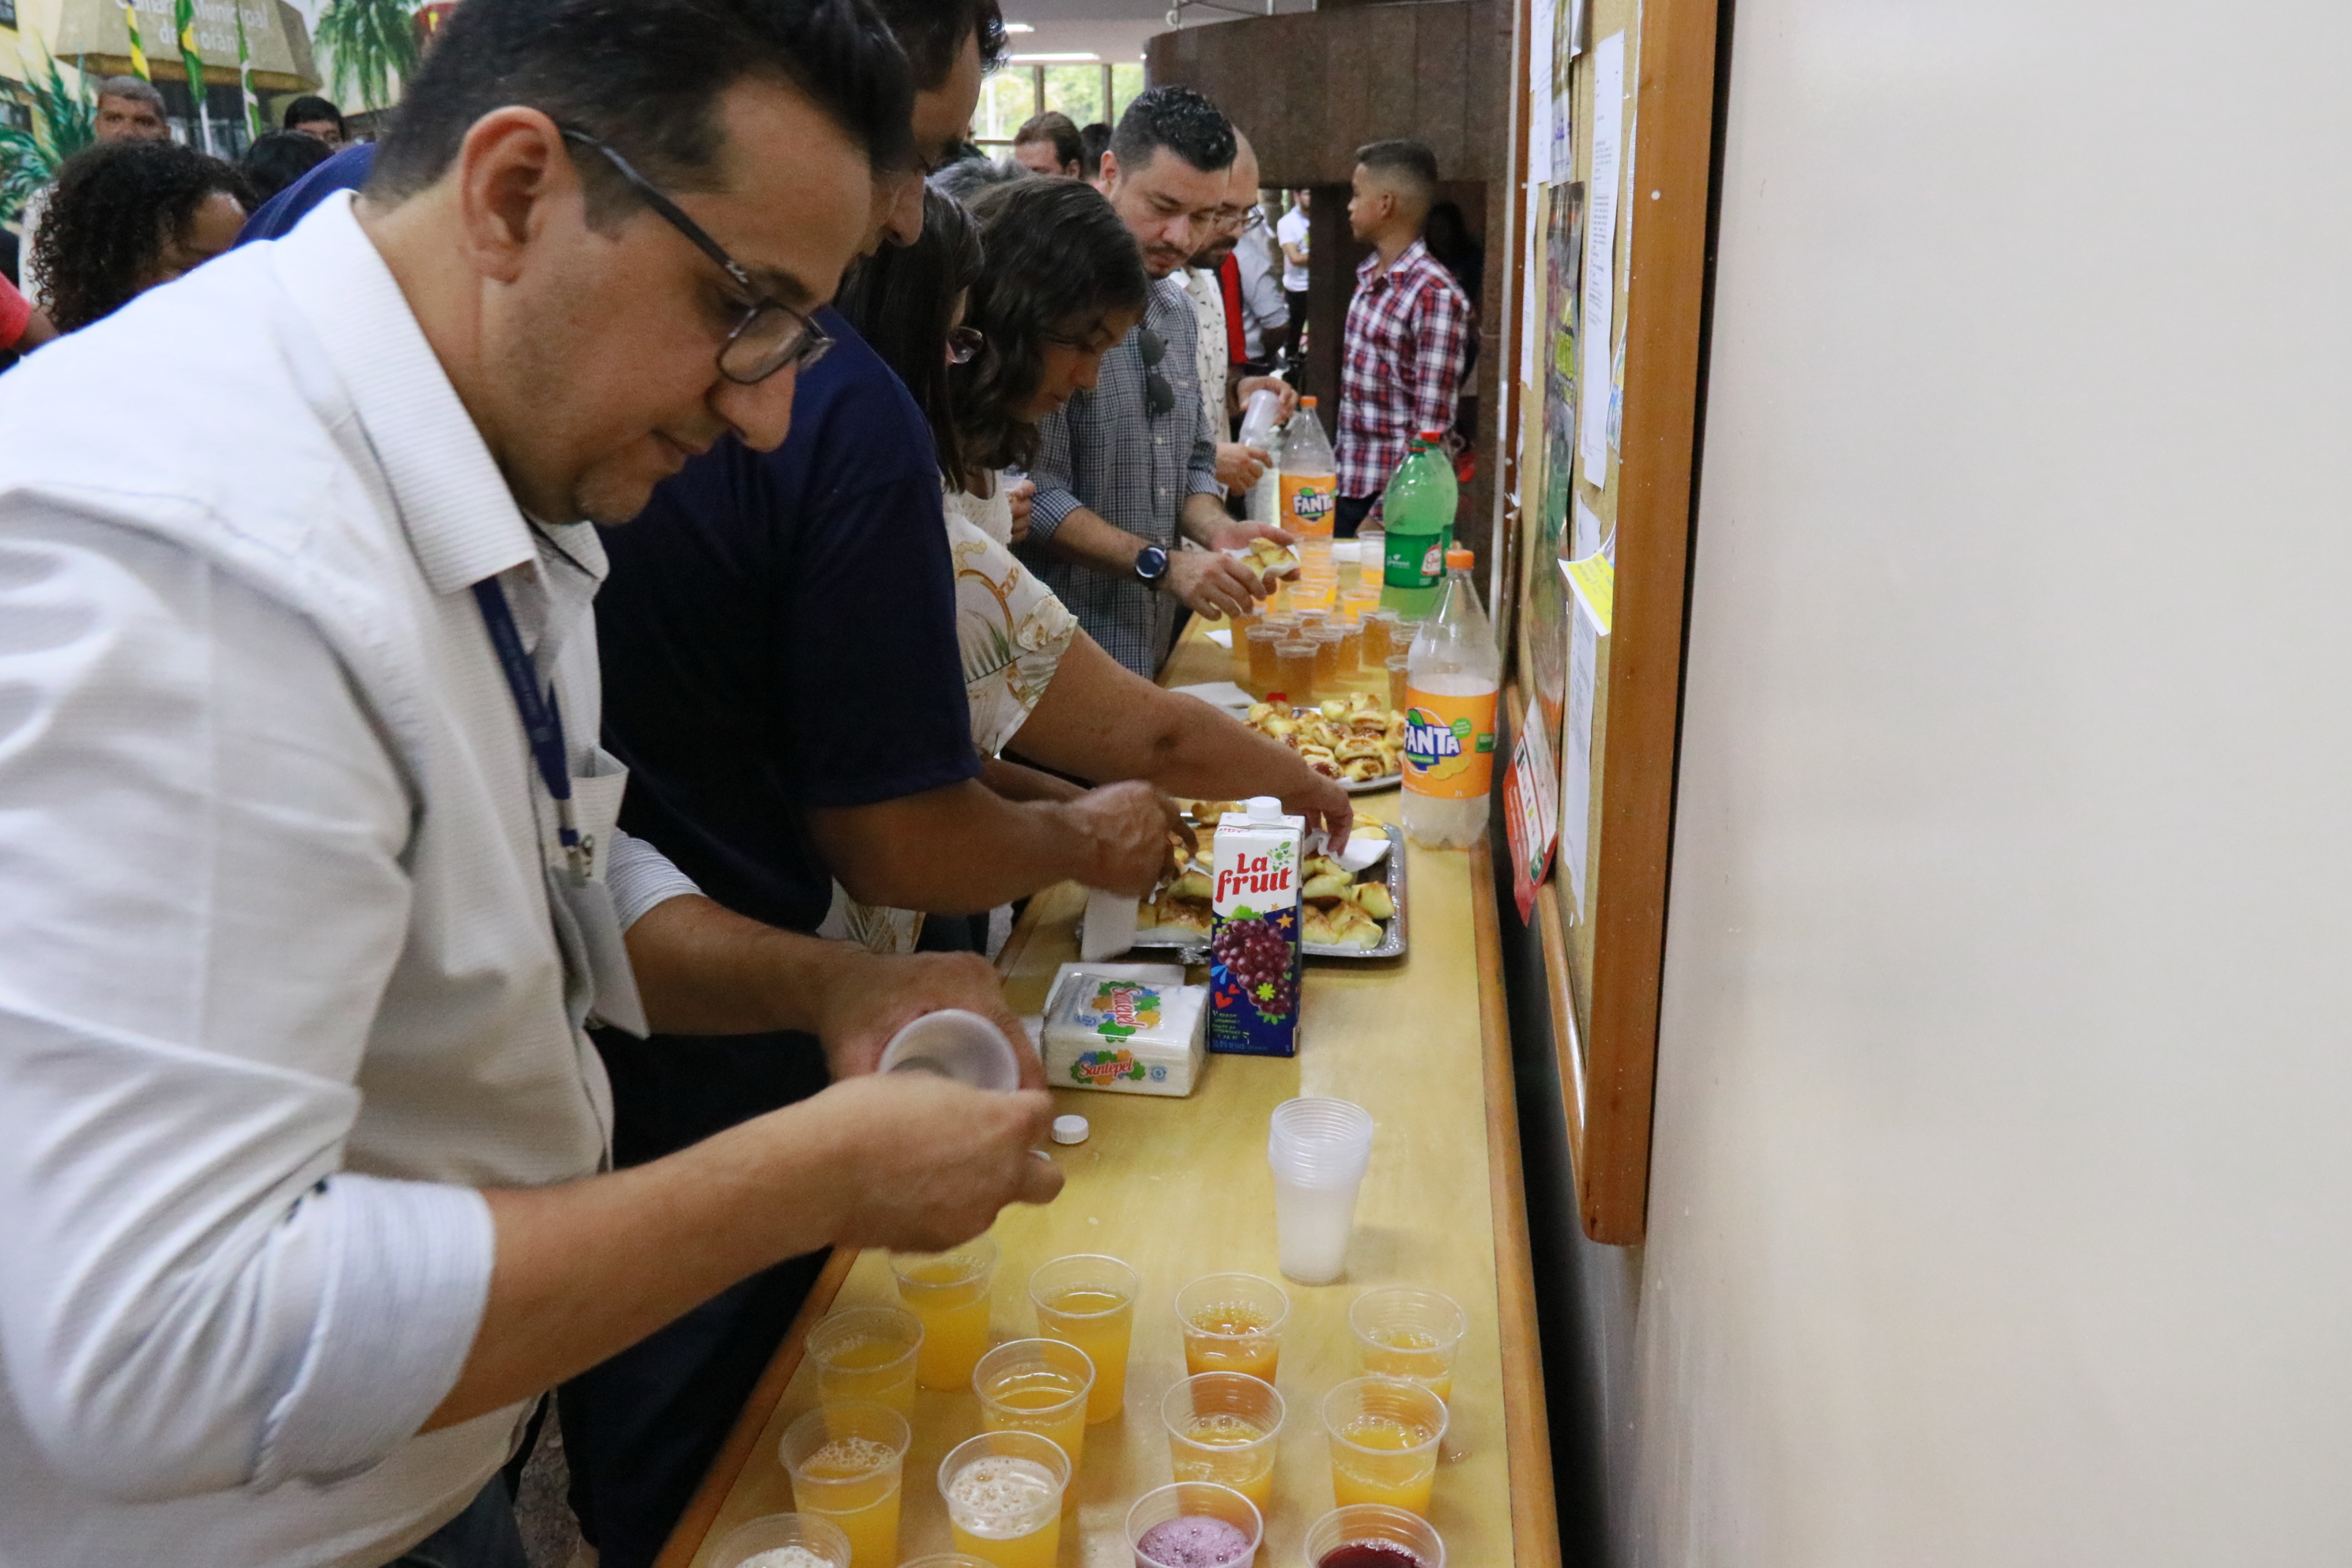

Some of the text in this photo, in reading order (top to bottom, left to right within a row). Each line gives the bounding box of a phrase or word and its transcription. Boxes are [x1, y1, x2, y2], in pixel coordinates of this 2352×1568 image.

[1237, 853, 1268, 873] La
[1215, 867, 1292, 903] fruit
[1106, 987, 1146, 1027] Santepel
[1078, 1057, 1133, 1078] Santepel
